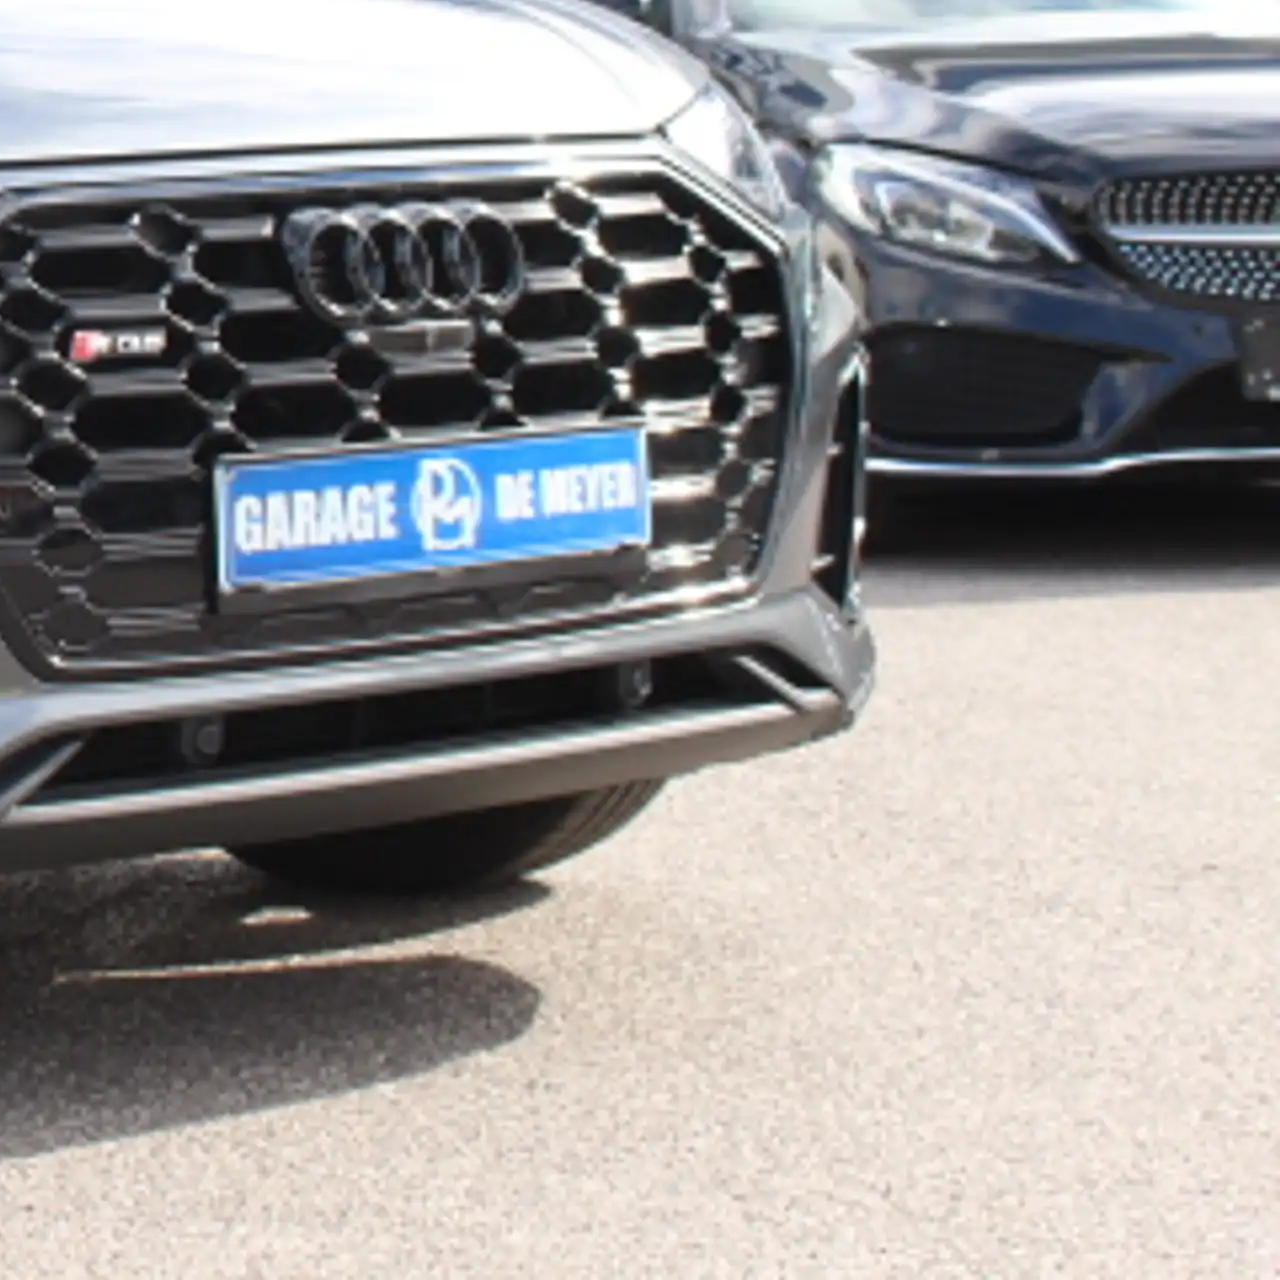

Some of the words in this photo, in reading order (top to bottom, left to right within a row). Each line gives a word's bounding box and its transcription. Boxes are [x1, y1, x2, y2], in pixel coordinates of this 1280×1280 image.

[234, 481, 399, 553] GARAGE
[495, 471, 537, 521] DE
[540, 461, 638, 517] MEYER
